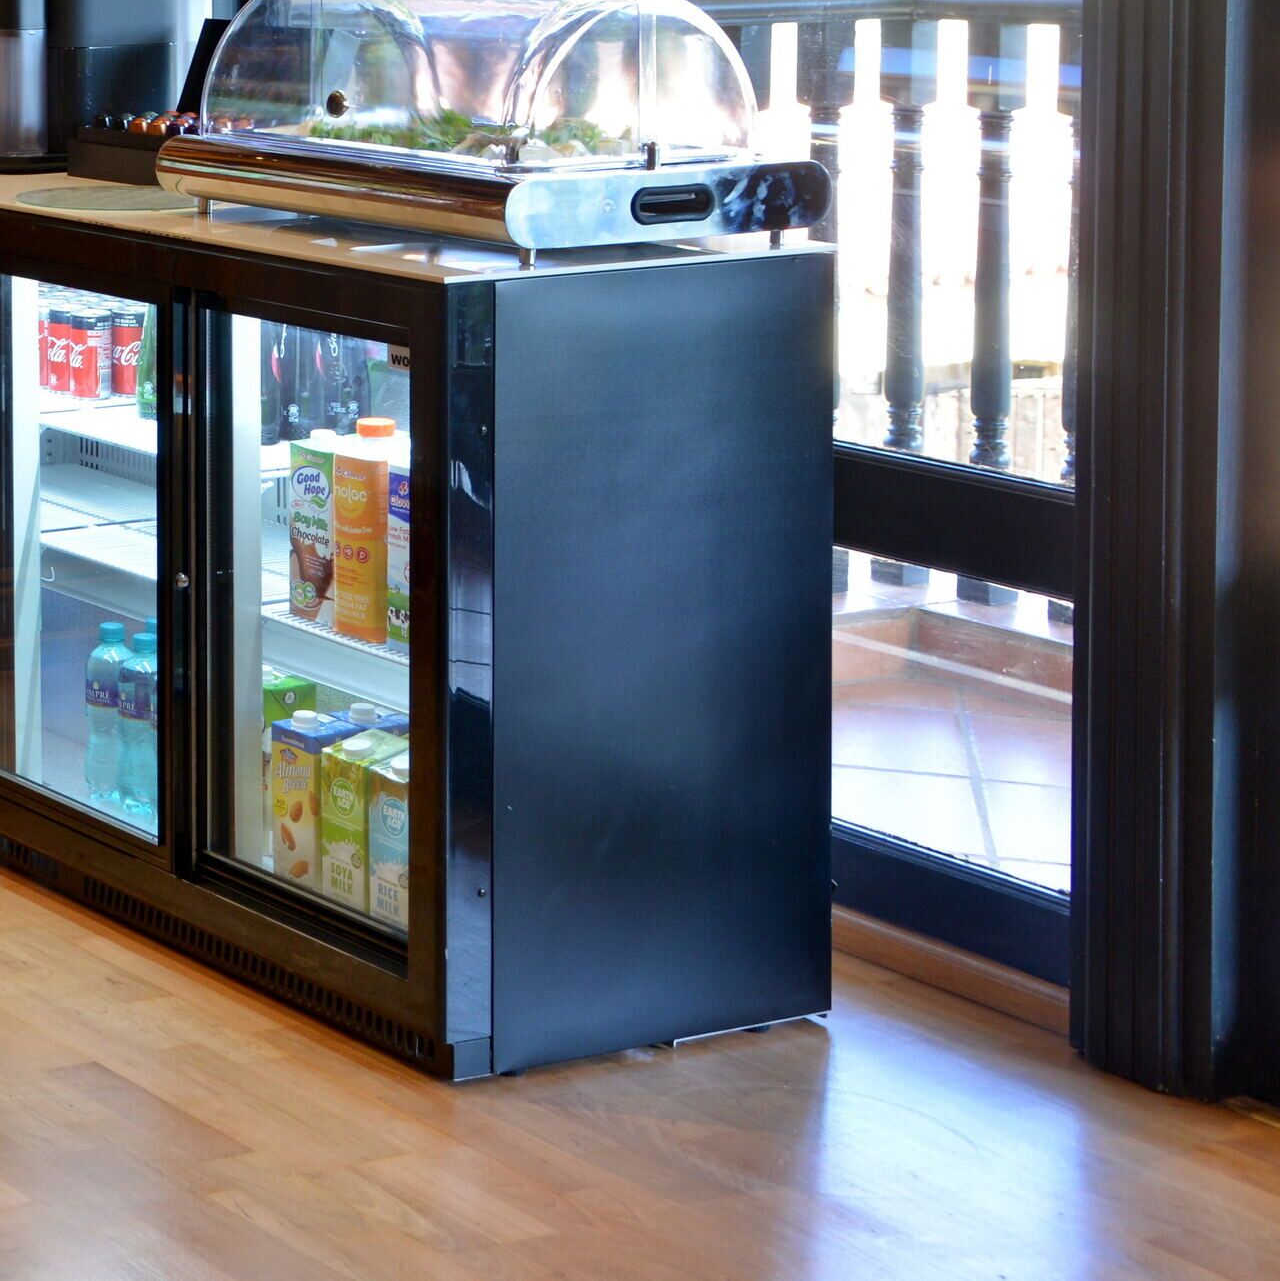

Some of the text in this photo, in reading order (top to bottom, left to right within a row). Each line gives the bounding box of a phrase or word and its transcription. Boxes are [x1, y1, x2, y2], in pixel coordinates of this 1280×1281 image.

[297, 472, 320, 484] Good
[304, 484, 325, 495] Hope
[292, 527, 330, 548] Chocolate
[275, 763, 312, 778] Almond
[333, 787, 354, 801] EARTH
[383, 805, 405, 822] EARTH
[330, 863, 354, 880] SOYA
[330, 879, 353, 896] MILK
[378, 883, 400, 900] RICE
[377, 899, 400, 917] MILK
